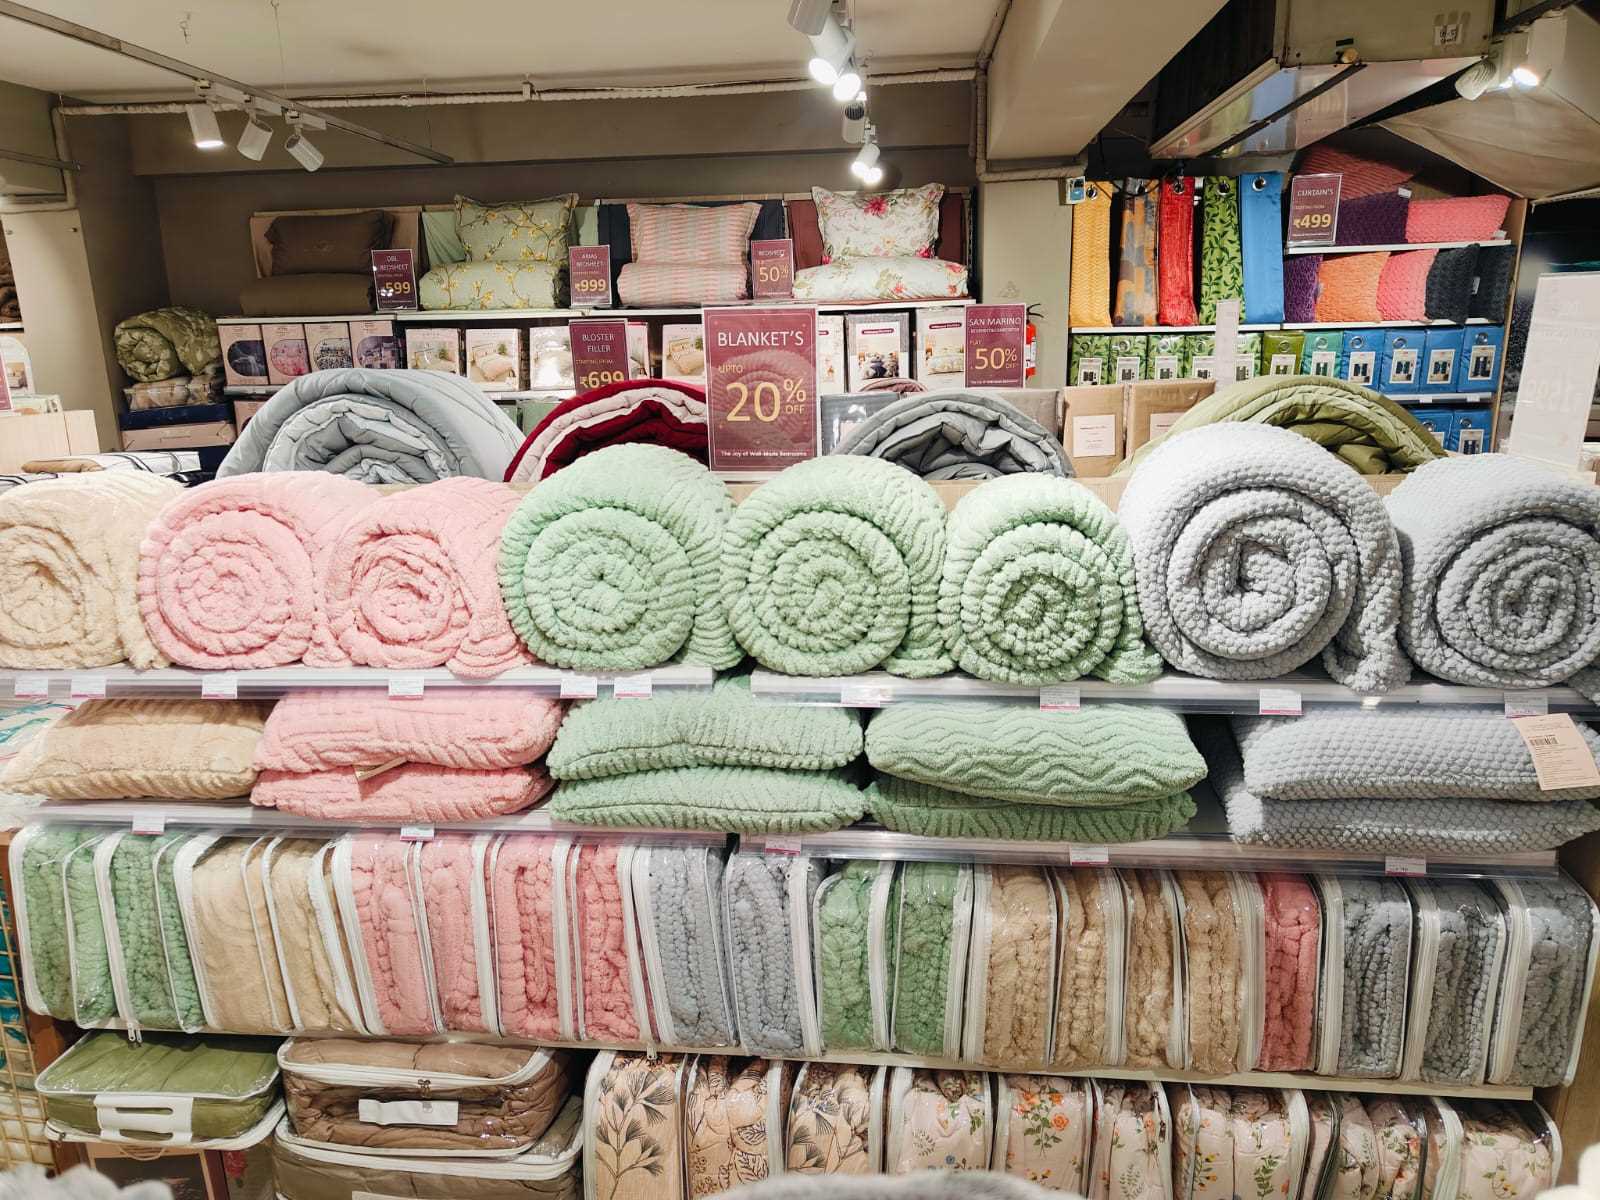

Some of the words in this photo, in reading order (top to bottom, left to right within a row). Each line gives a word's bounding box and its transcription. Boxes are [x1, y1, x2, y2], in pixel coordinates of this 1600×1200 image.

[1294, 213, 1332, 229] ₹499
[379, 281, 411, 295] 599
[574, 279, 607, 292] ₹999
[969, 318, 985, 326] SAN
[987, 316, 1022, 326] MARINO
[717, 330, 804, 347] BLANKET'S
[587, 344, 612, 353] FILLER
[974, 347, 1018, 370] 50%
[718, 364, 743, 374] UPTO
[579, 370, 625, 389] ₹699
[726, 377, 807, 422] 20%
[785, 404, 806, 414] OFF
